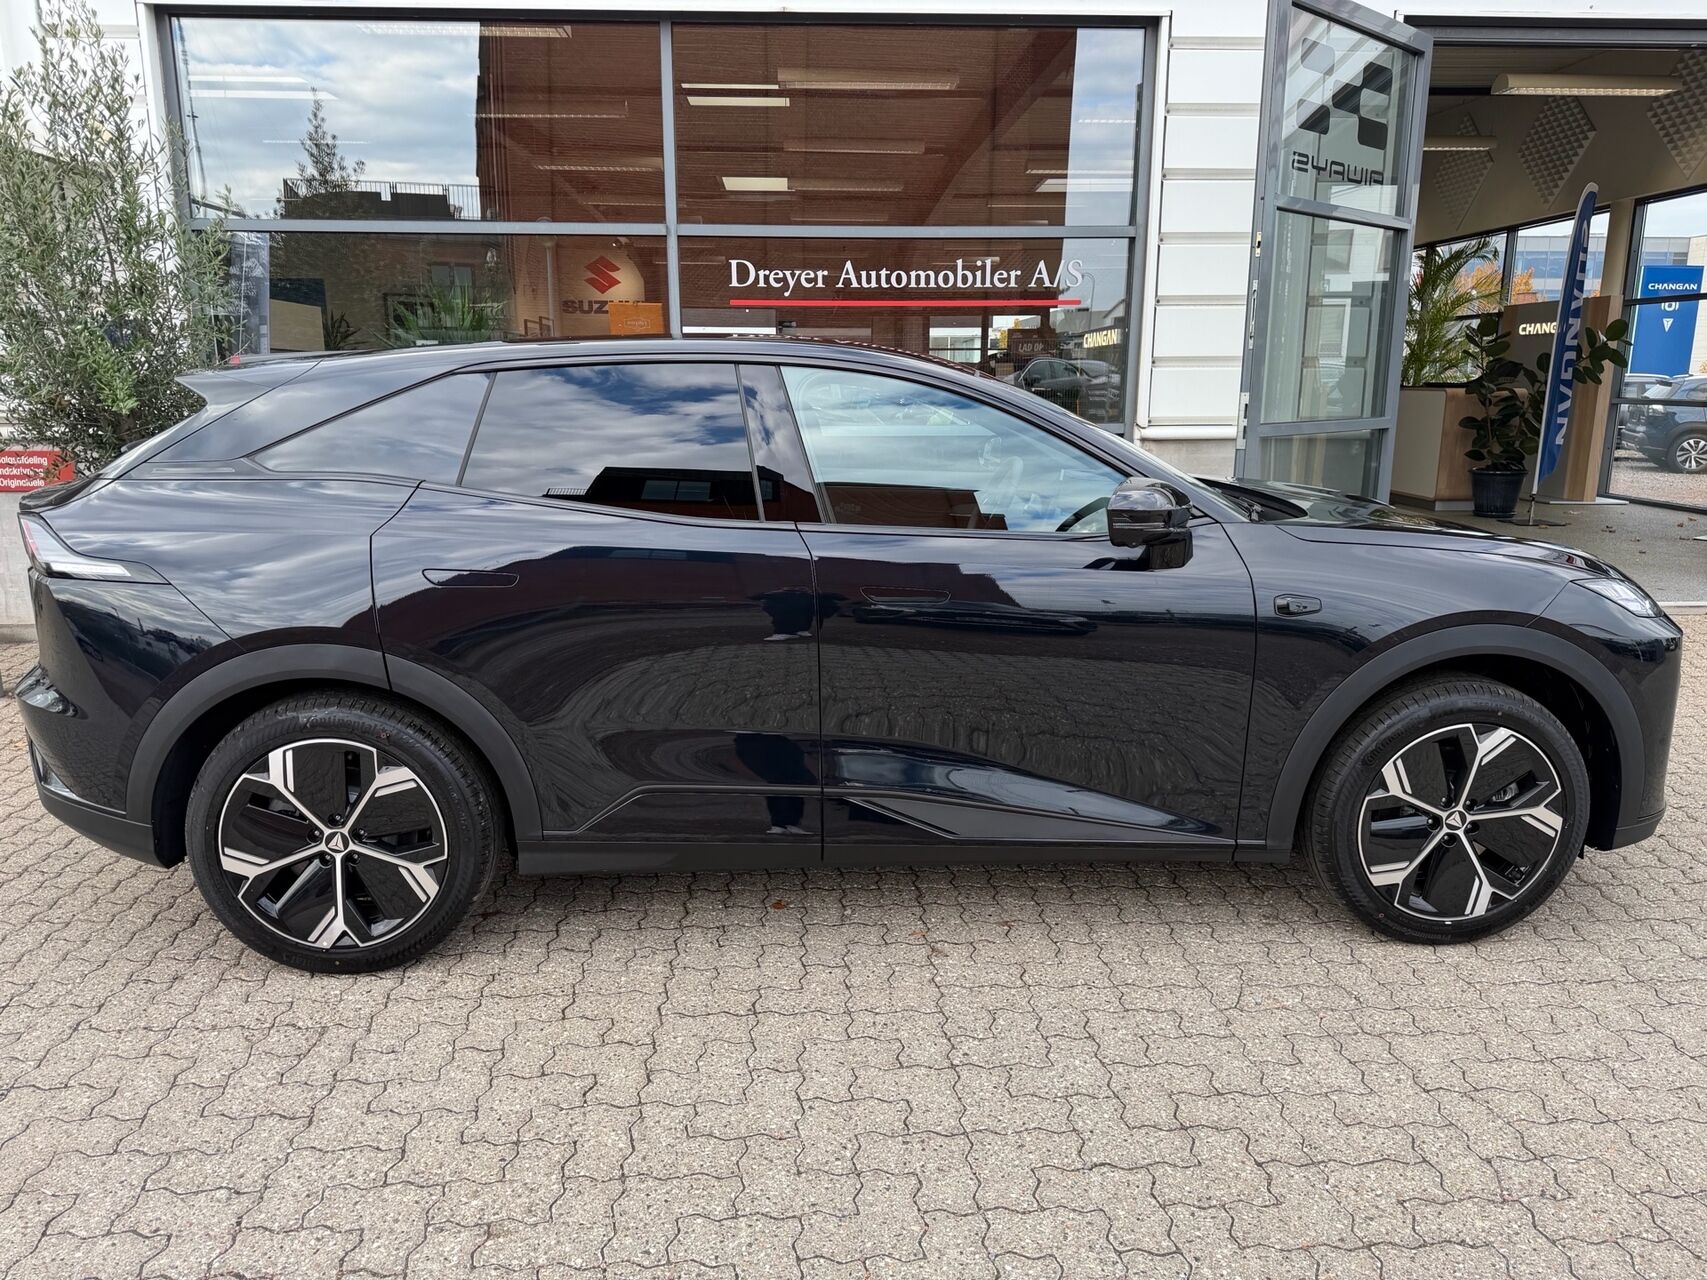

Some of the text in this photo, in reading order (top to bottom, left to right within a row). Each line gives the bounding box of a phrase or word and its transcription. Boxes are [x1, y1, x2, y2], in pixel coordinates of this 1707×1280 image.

[728, 258, 1084, 297] Dreyer Automobiler A/S
[562, 299, 640, 314] SUZ
[1518, 321, 1558, 336] CHANG
[1083, 329, 1118, 348] CHANGAN
